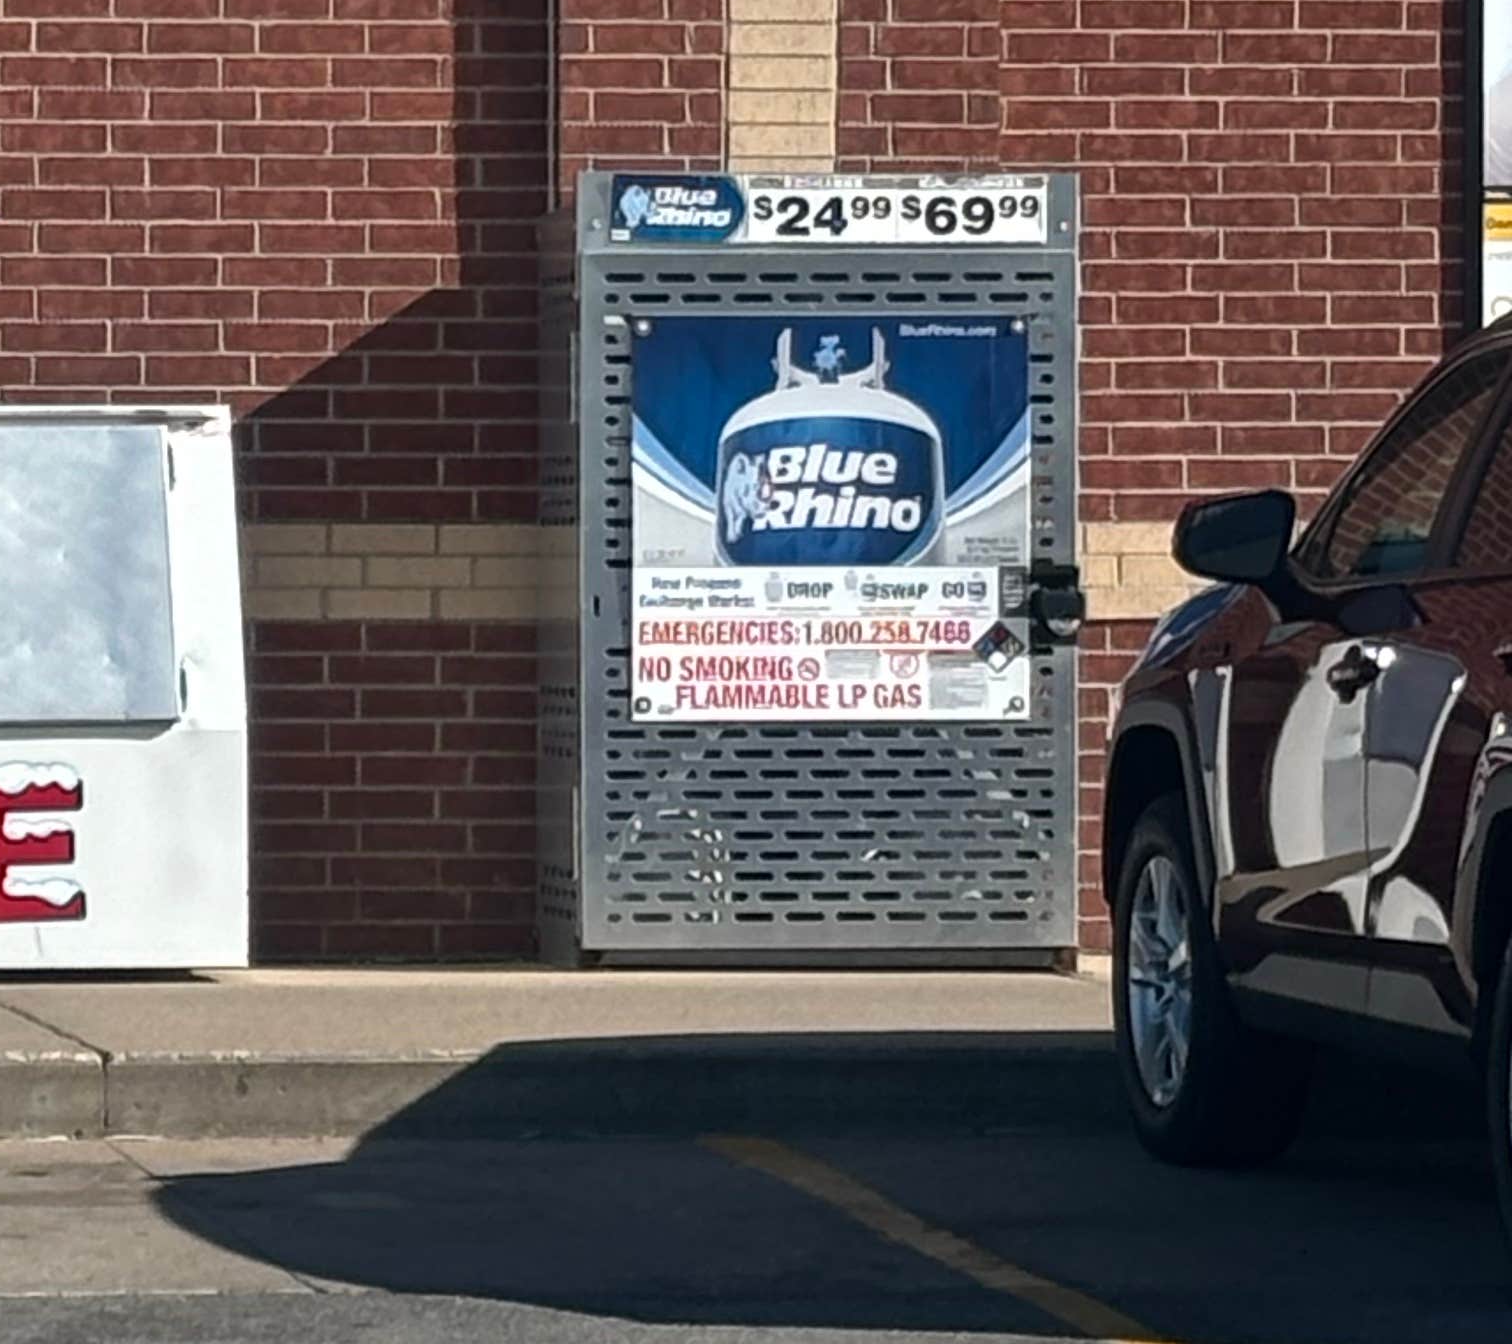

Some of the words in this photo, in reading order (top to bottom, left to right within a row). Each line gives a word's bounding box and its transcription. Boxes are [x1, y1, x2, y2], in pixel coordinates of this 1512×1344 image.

[655, 187, 717, 207] Blue
[646, 204, 732, 229] Rhino
[767, 445, 898, 484] Blue
[754, 487, 922, 534] Rhino
[786, 582, 834, 599] DROP
[879, 582, 929, 600] SWAP
[639, 657, 671, 681] NO
[679, 657, 793, 681] SMOKING
[675, 685, 830, 709] FLAMMABLE
[837, 685, 867, 709] LP
[873, 685, 922, 709] GAS
